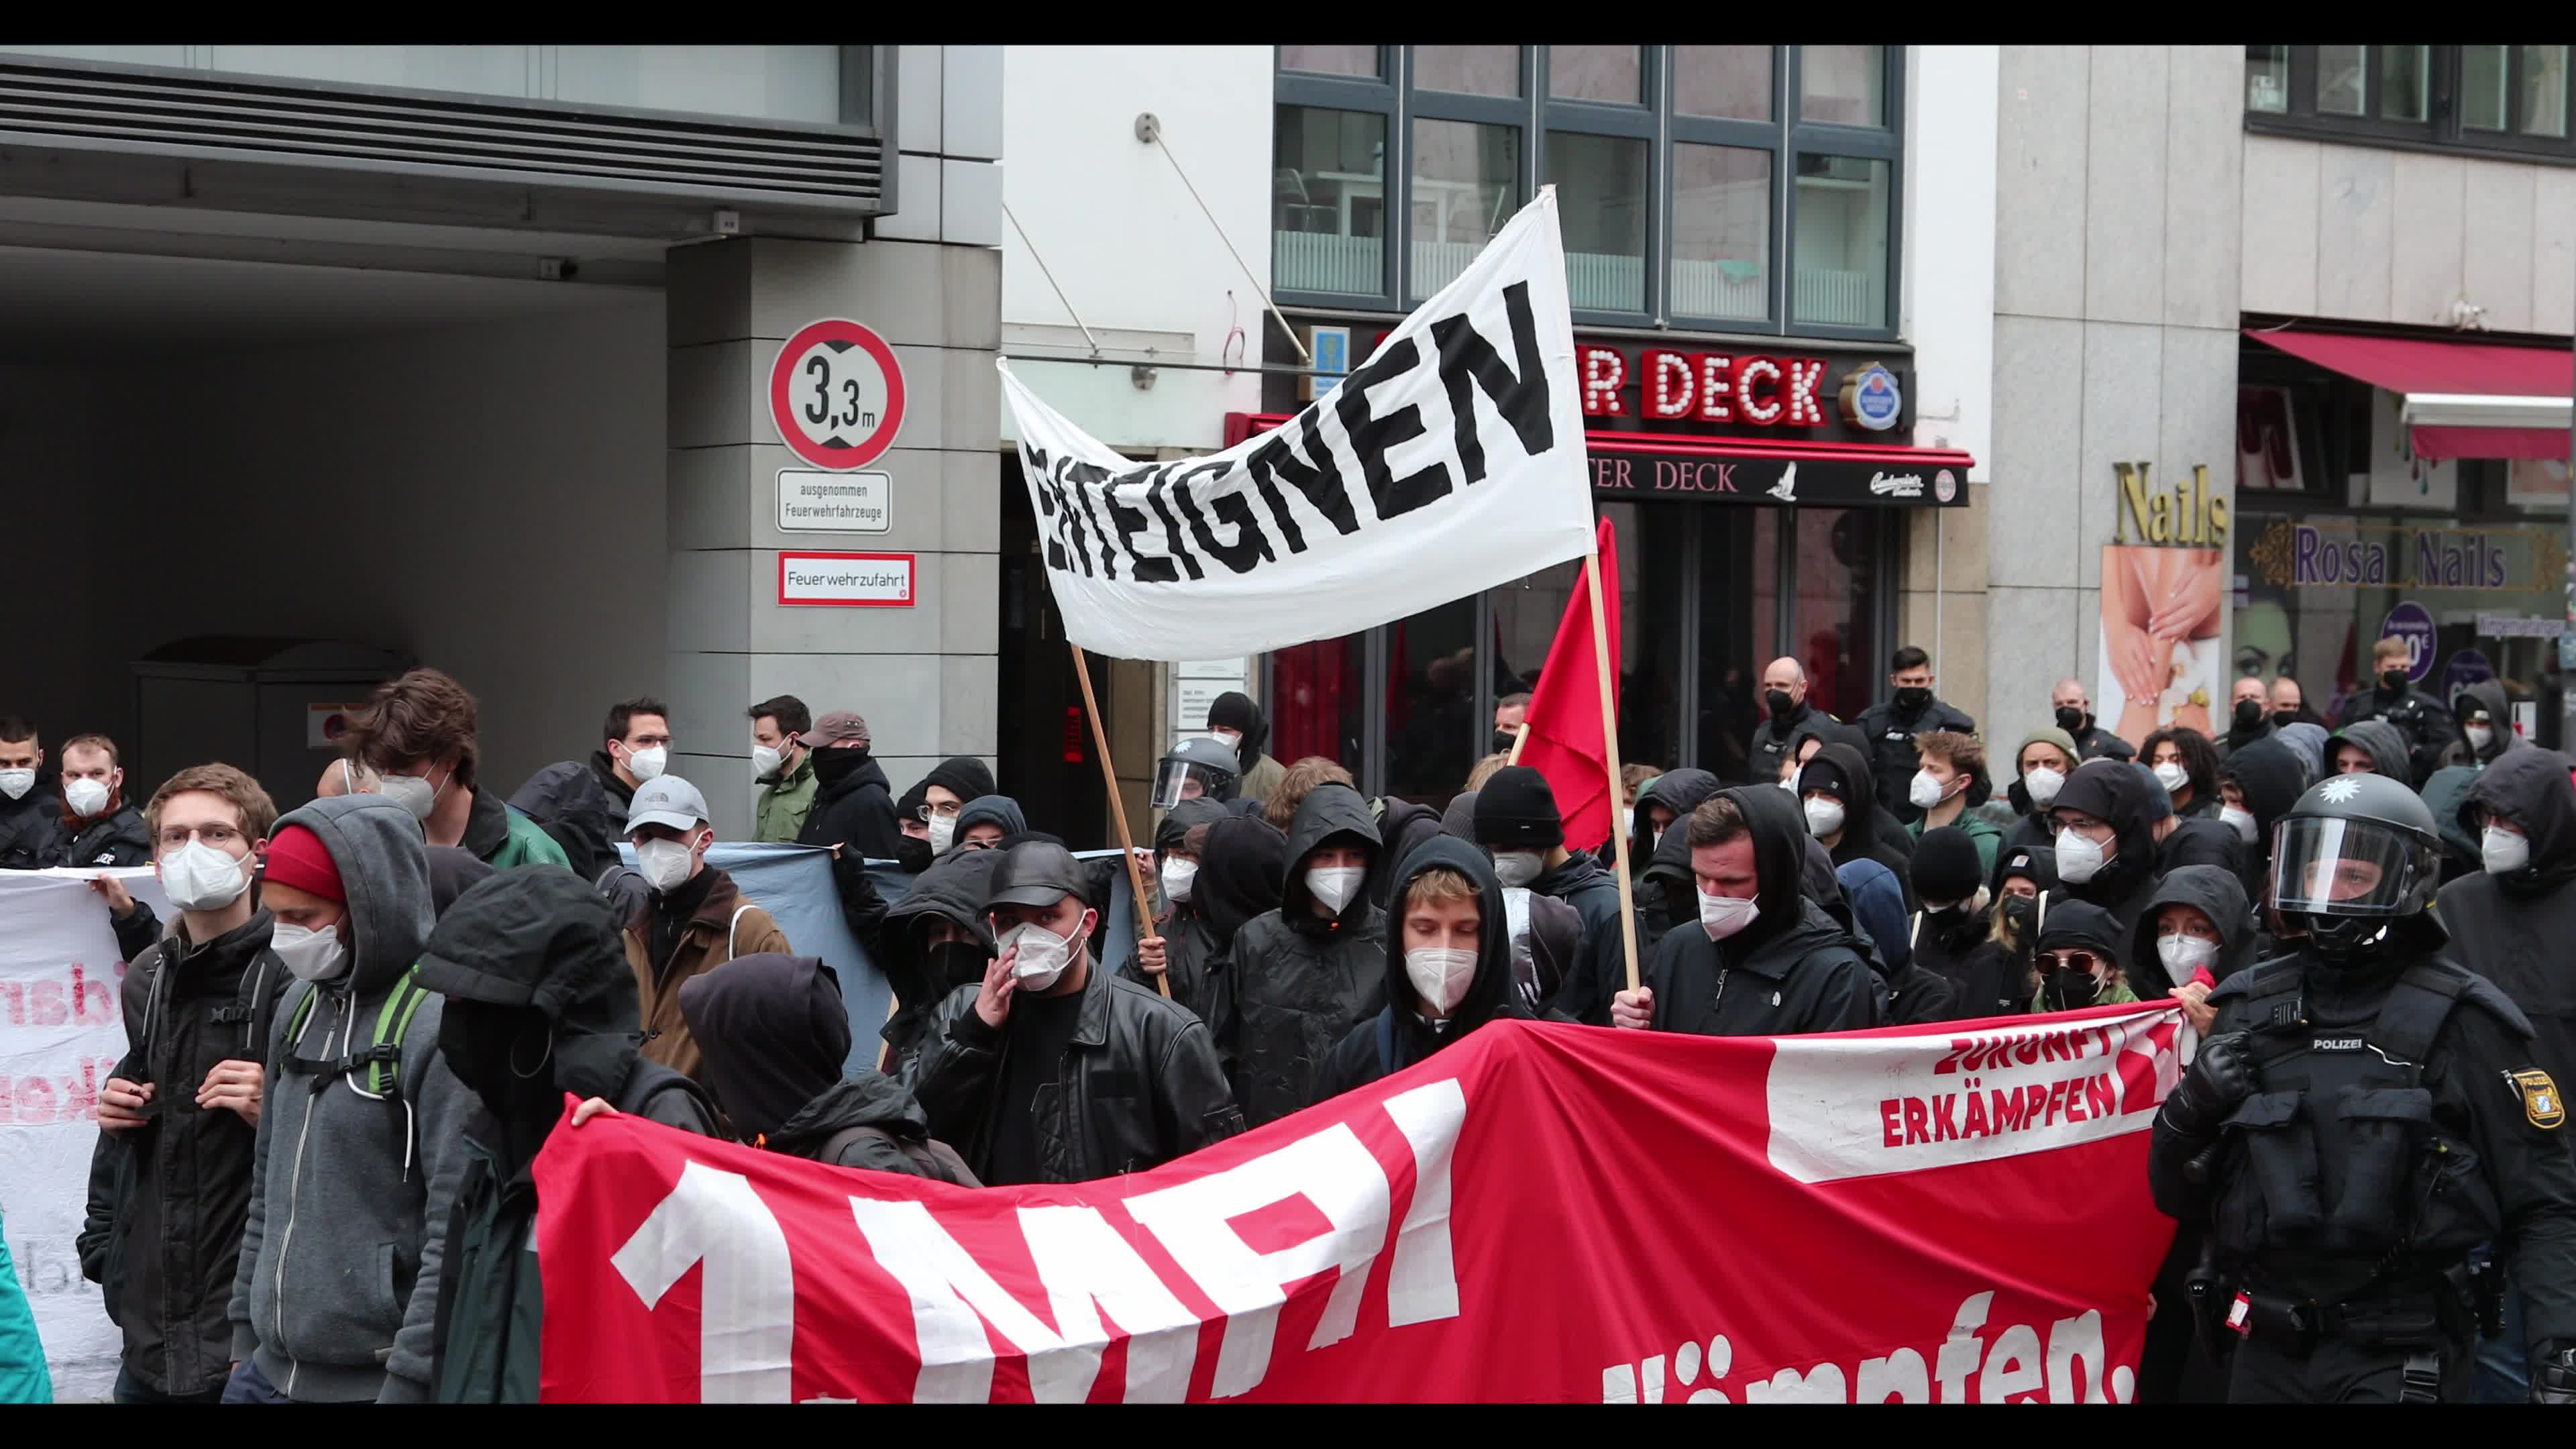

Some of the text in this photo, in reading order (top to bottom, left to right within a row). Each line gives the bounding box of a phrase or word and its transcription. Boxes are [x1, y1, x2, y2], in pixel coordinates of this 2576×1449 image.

[1643, 348, 1827, 427] DECK
[800, 483, 867, 498] ausgenommen
[1654, 461, 1739, 493] DECK
[785, 502, 882, 521] Feuerwehrfahrzeuge
[2113, 461, 2228, 547] Nails
[2294, 525, 2508, 588] Rosa Nails
[788, 571, 906, 588] Feuerwehrzufahrt
[2394, 633, 2430, 666] 0€
[1934, 1026, 2112, 1075] ZUKUNFT
[2314, 1038, 2362, 1050] POLIZEI
[1880, 1073, 2117, 1148] ERKÄMPFEN
[610, 1077, 1466, 1403] 1 MAI
